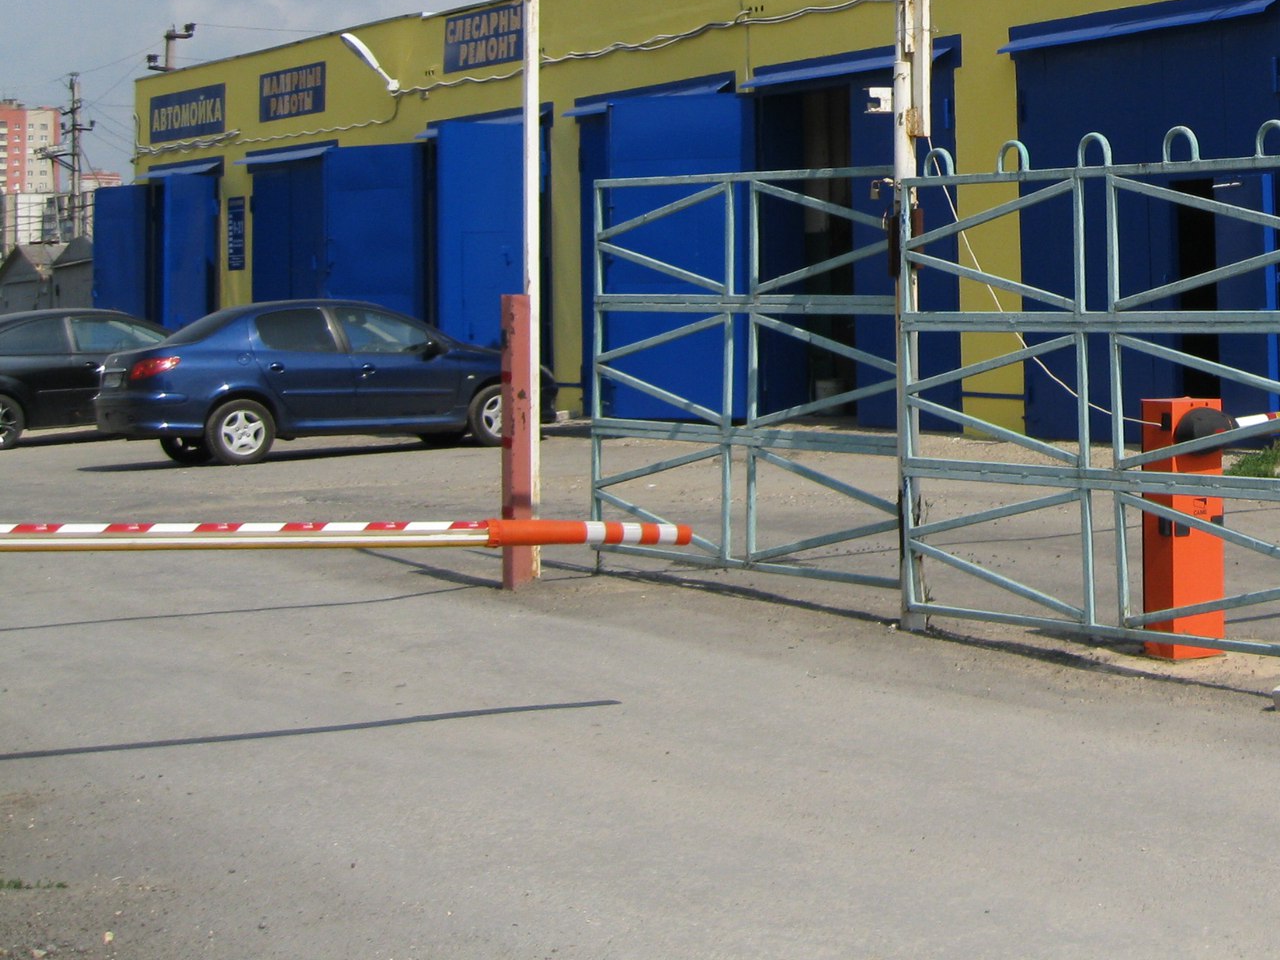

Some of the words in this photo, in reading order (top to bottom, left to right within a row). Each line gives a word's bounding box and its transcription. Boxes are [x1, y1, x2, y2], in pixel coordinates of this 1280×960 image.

[446, 6, 523, 44] СЛЕСАРНЫ
[459, 34, 517, 66] РЕМОНТ
[152, 95, 222, 132] АВТОМОЙКА
